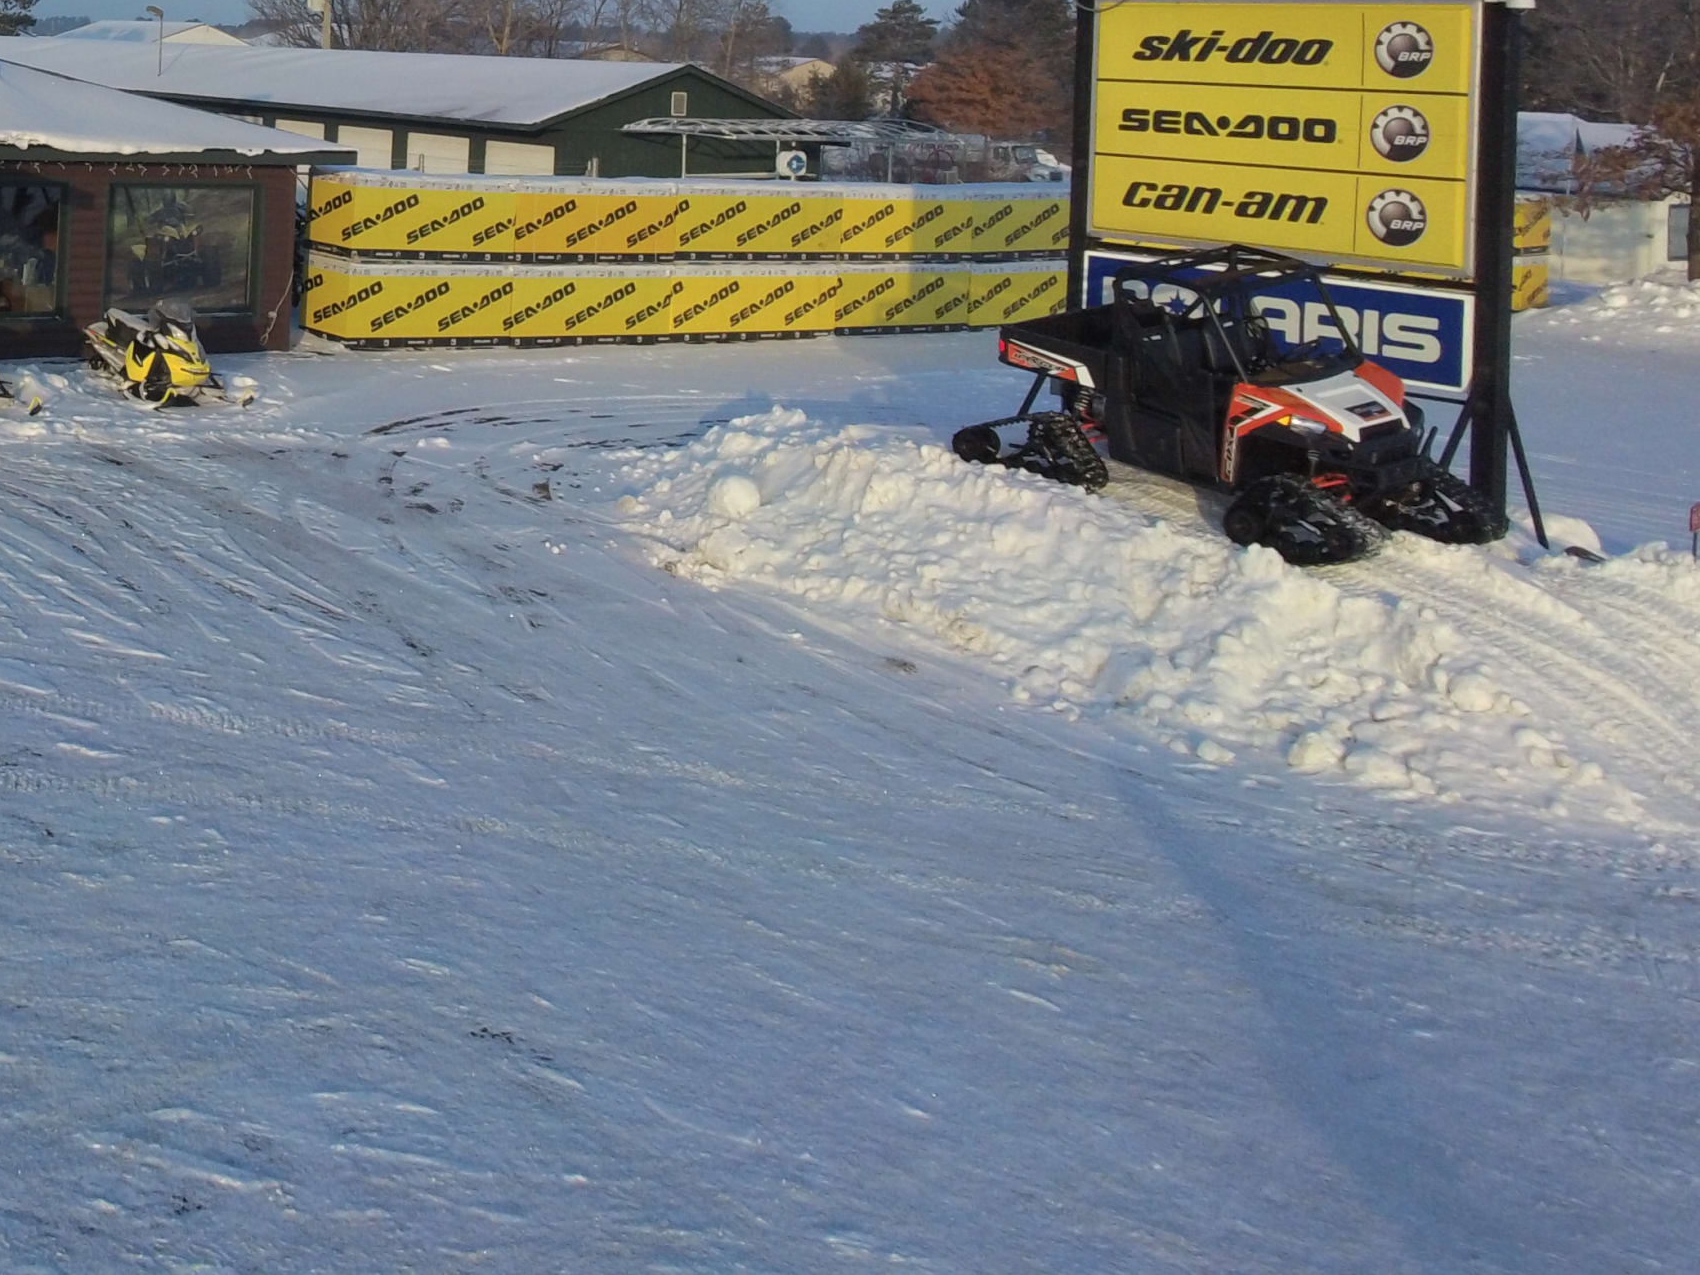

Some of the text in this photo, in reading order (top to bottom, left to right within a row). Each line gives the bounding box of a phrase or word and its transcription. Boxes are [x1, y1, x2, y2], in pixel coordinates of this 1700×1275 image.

[1132, 29, 1334, 66] ski-doo
[1397, 50, 1432, 63] BRP
[1393, 134, 1428, 147] BRP
[1122, 181, 1329, 224] can-am
[1389, 219, 1425, 232] BRP
[1102, 276, 1441, 364] POARIS
